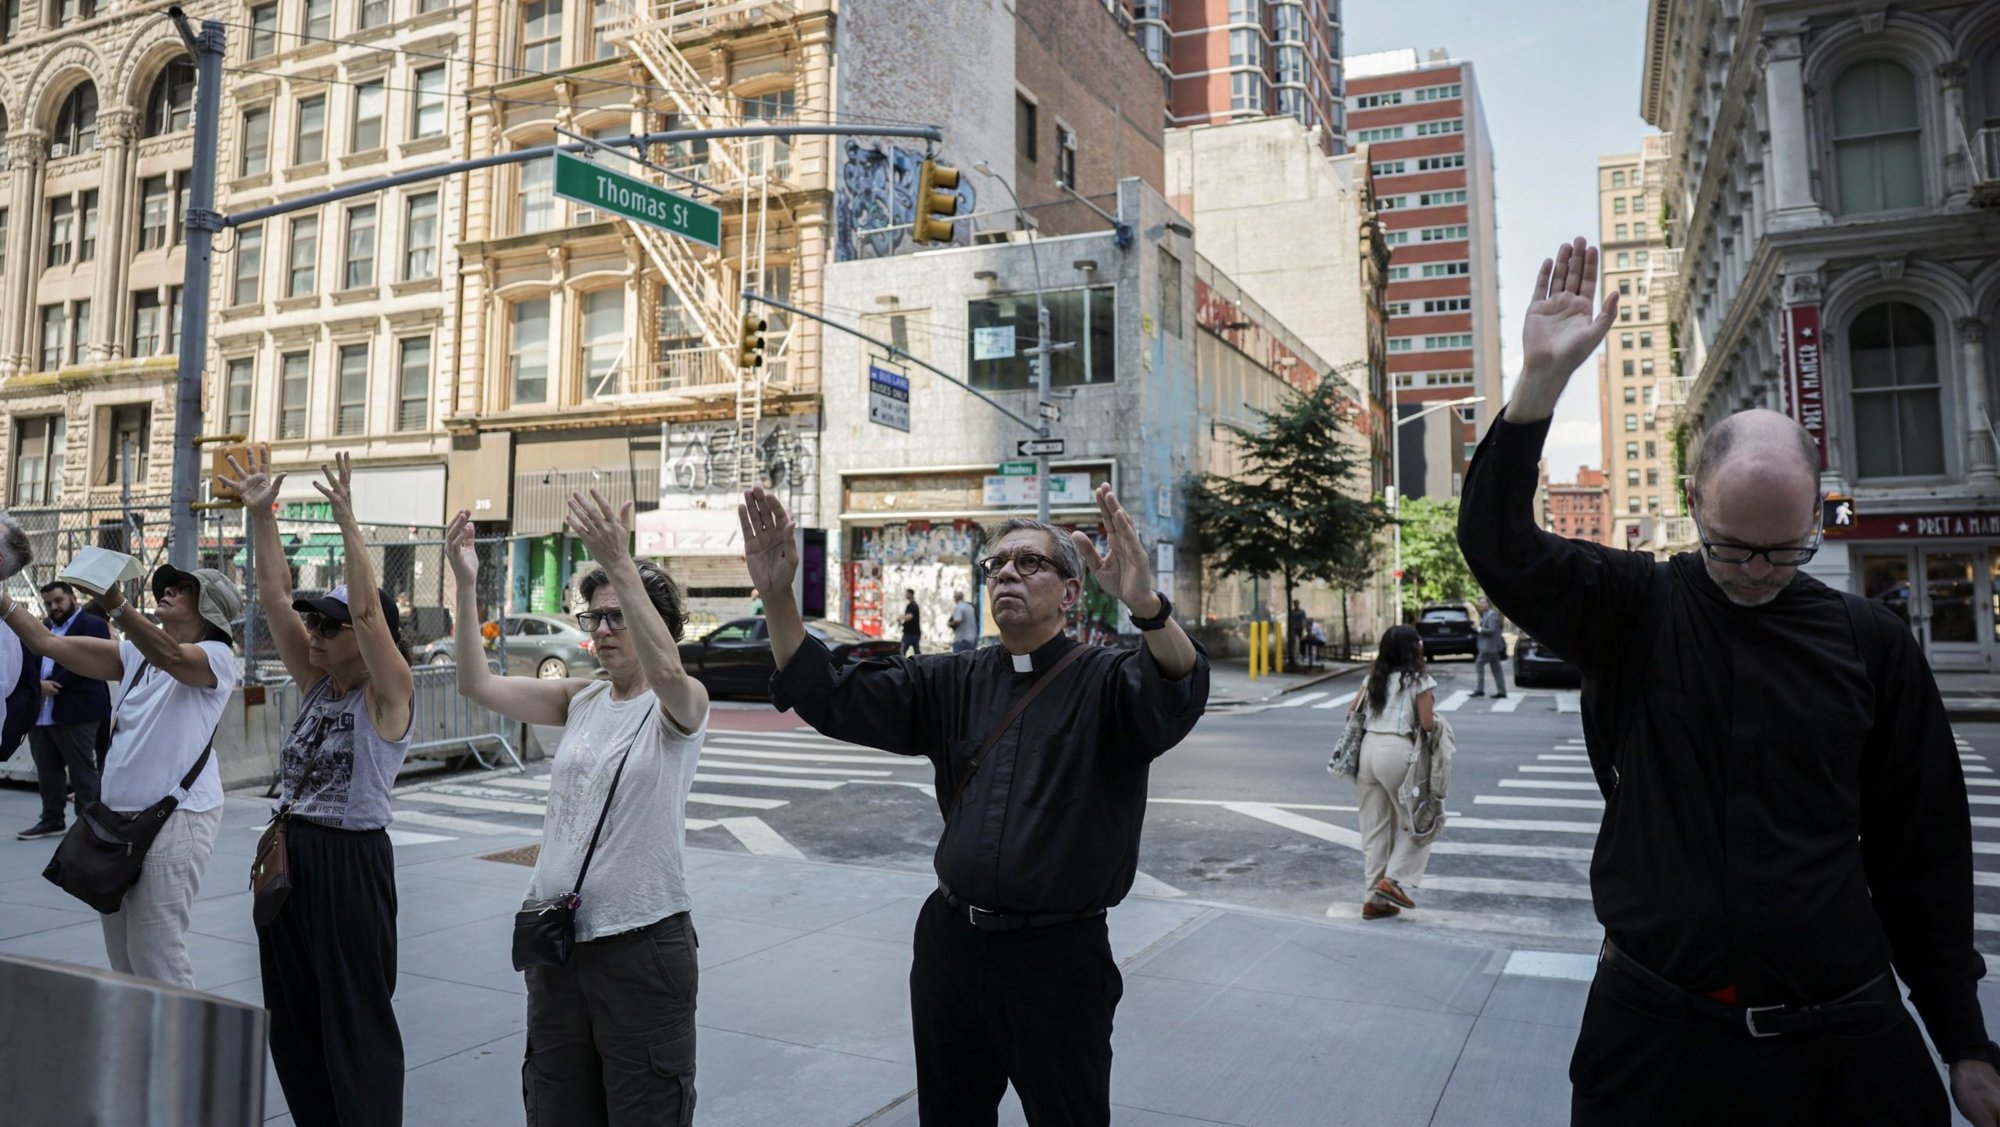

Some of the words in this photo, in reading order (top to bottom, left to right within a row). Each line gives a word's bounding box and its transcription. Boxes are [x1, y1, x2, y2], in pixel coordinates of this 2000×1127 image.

[597, 176, 666, 220] Thomas
[673, 203, 689, 228] St
[1799, 344, 1820, 389] MANGER
[1003, 466, 1033, 475] Broadway
[1918, 516, 1950, 535] PRET
[1955, 517, 1965, 535] A
[344, 715, 353, 725] ST
